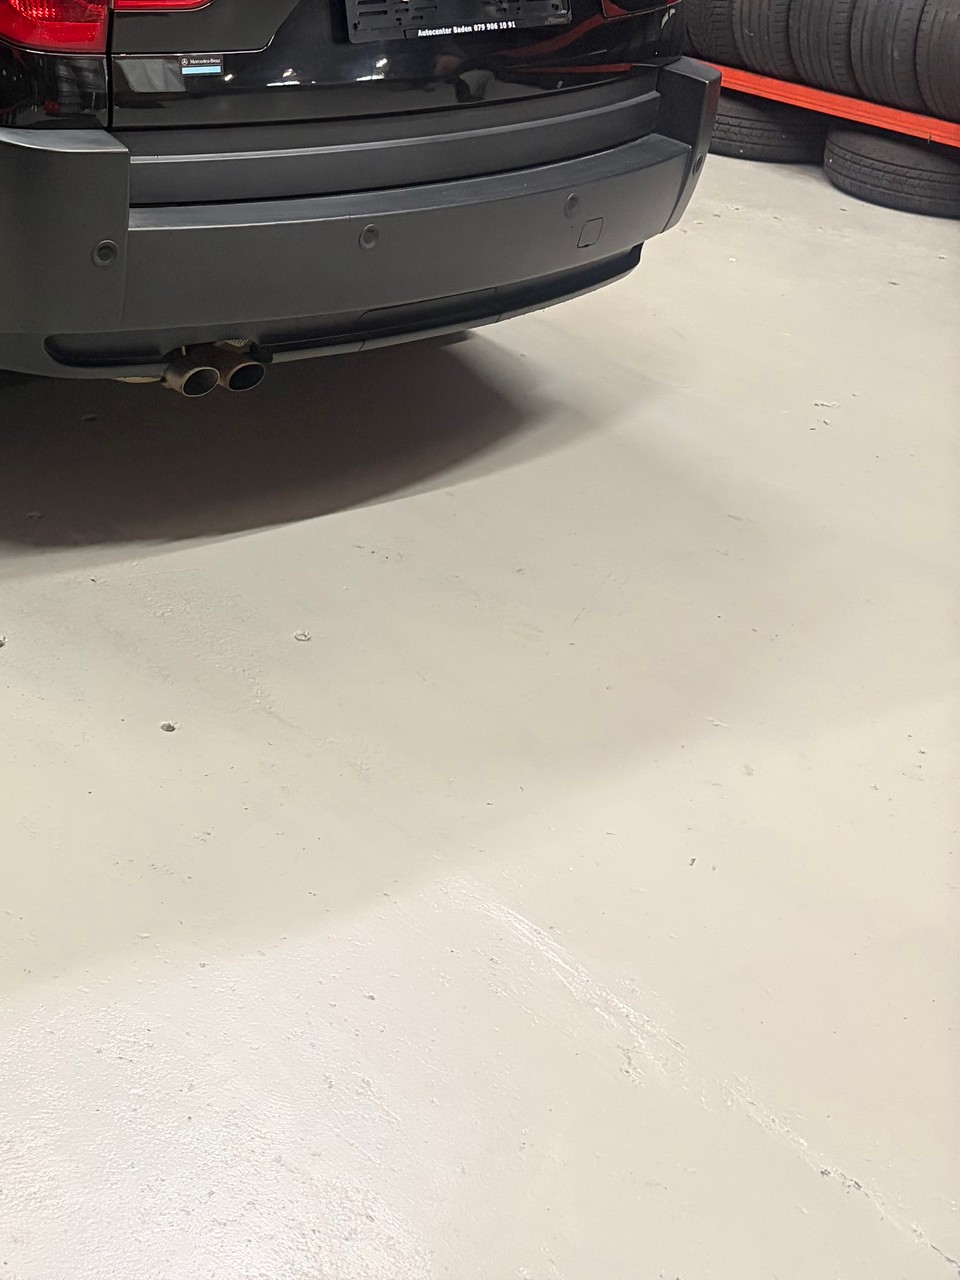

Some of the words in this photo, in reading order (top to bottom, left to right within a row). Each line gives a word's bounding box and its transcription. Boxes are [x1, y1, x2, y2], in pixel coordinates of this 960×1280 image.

[418, 27, 452, 37] Autocenter
[453, 25, 473, 34] Baden
[473, 24, 486, 32] 079
[499, 21, 507, 29] 10
[507, 20, 516, 28] 91
